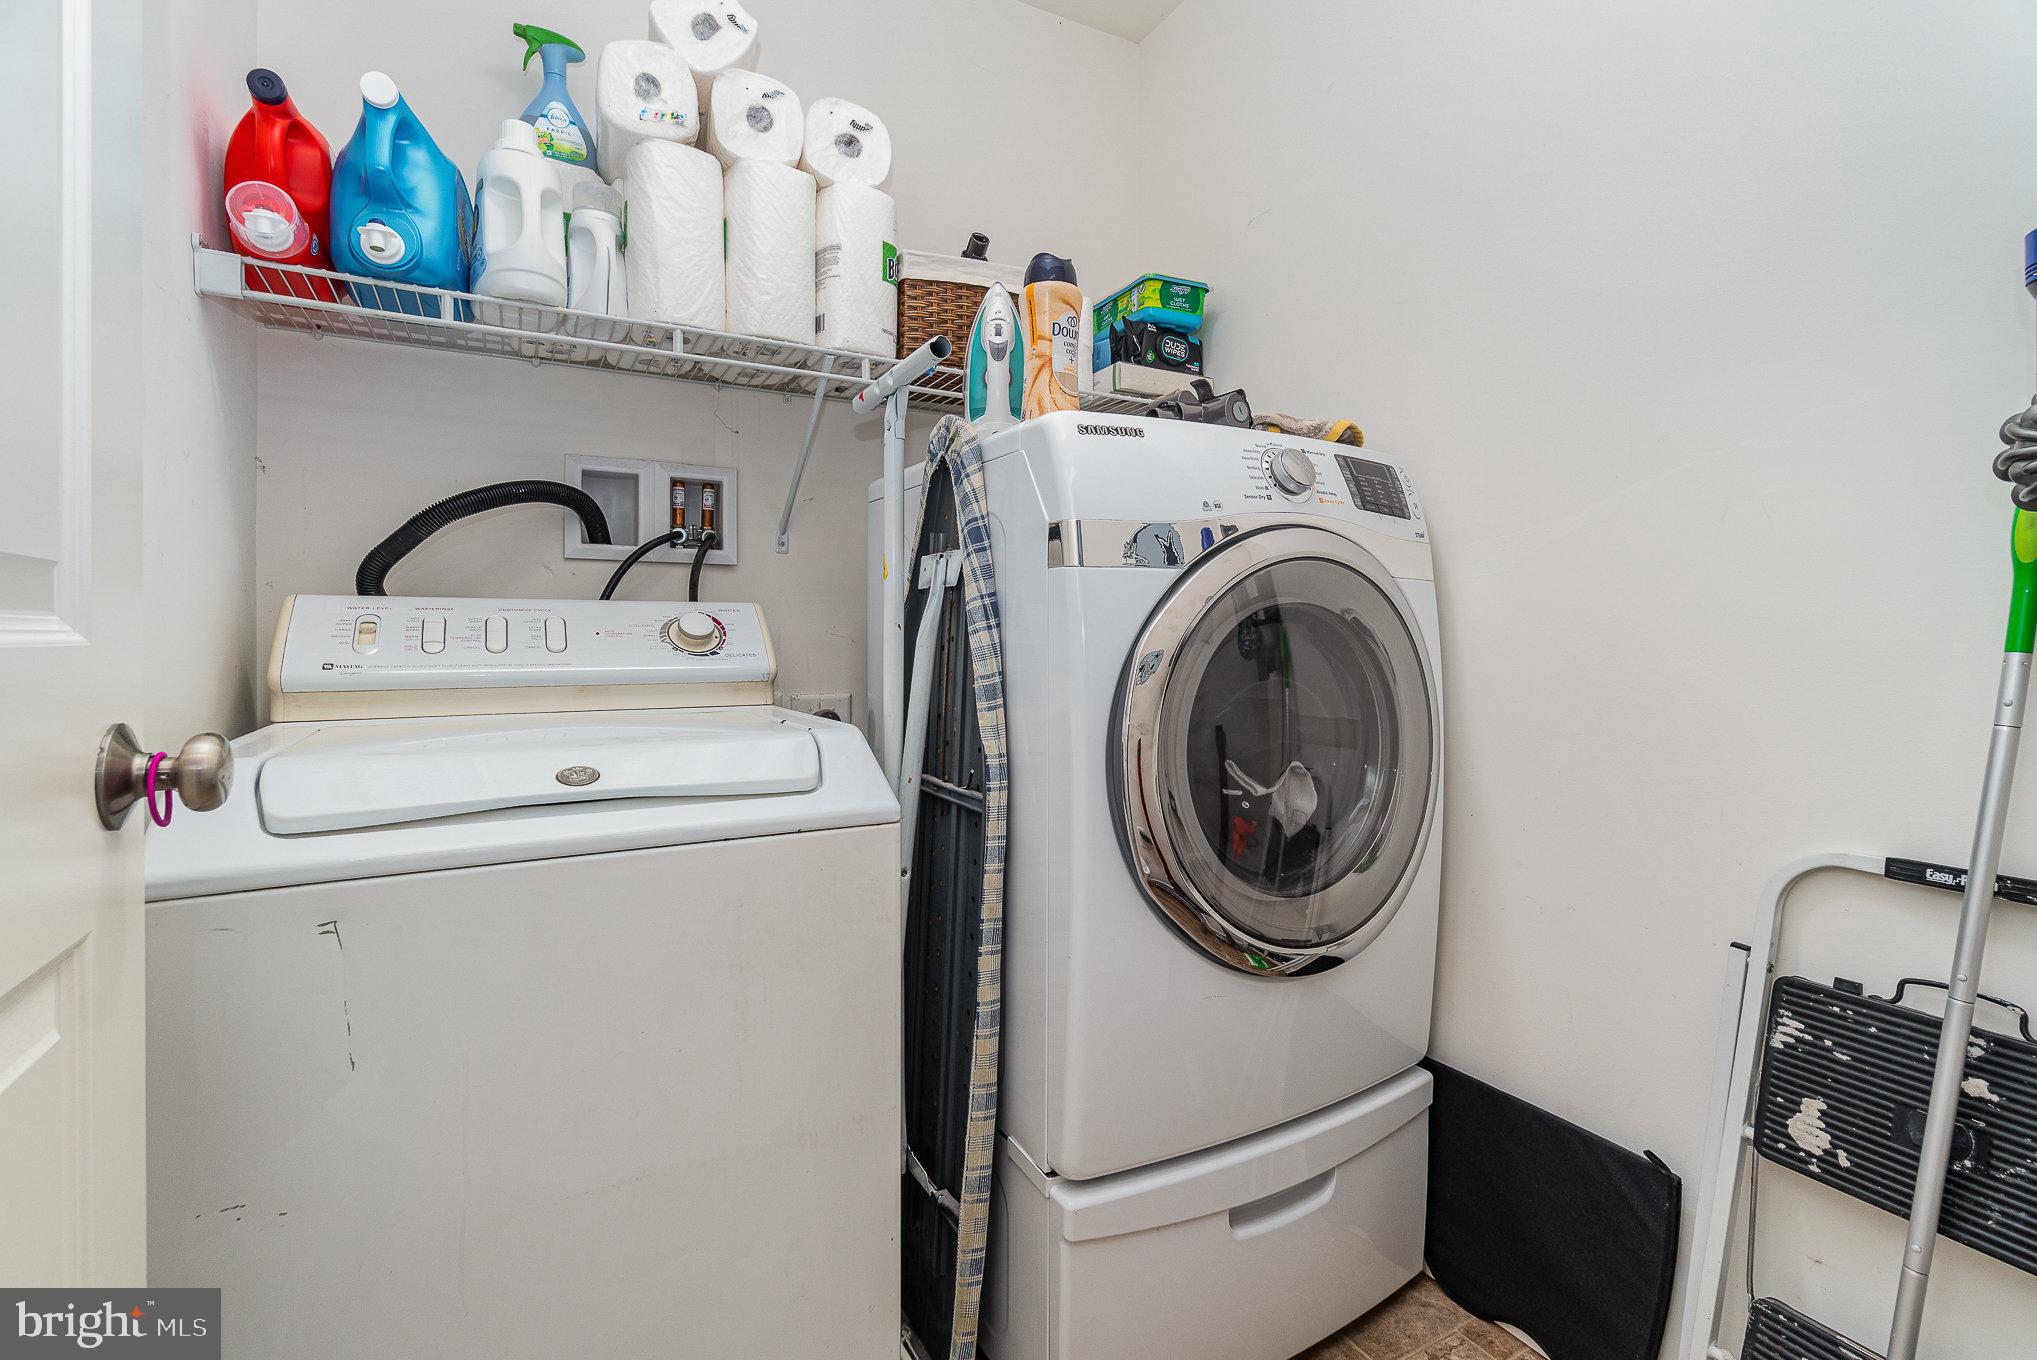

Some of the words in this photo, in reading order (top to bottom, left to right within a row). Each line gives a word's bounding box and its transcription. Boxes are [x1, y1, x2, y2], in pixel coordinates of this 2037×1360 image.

[1164, 339, 1187, 352] DUDE
[1164, 346, 1186, 358] WIPES
[1077, 424, 1145, 438] SAMSUNG
